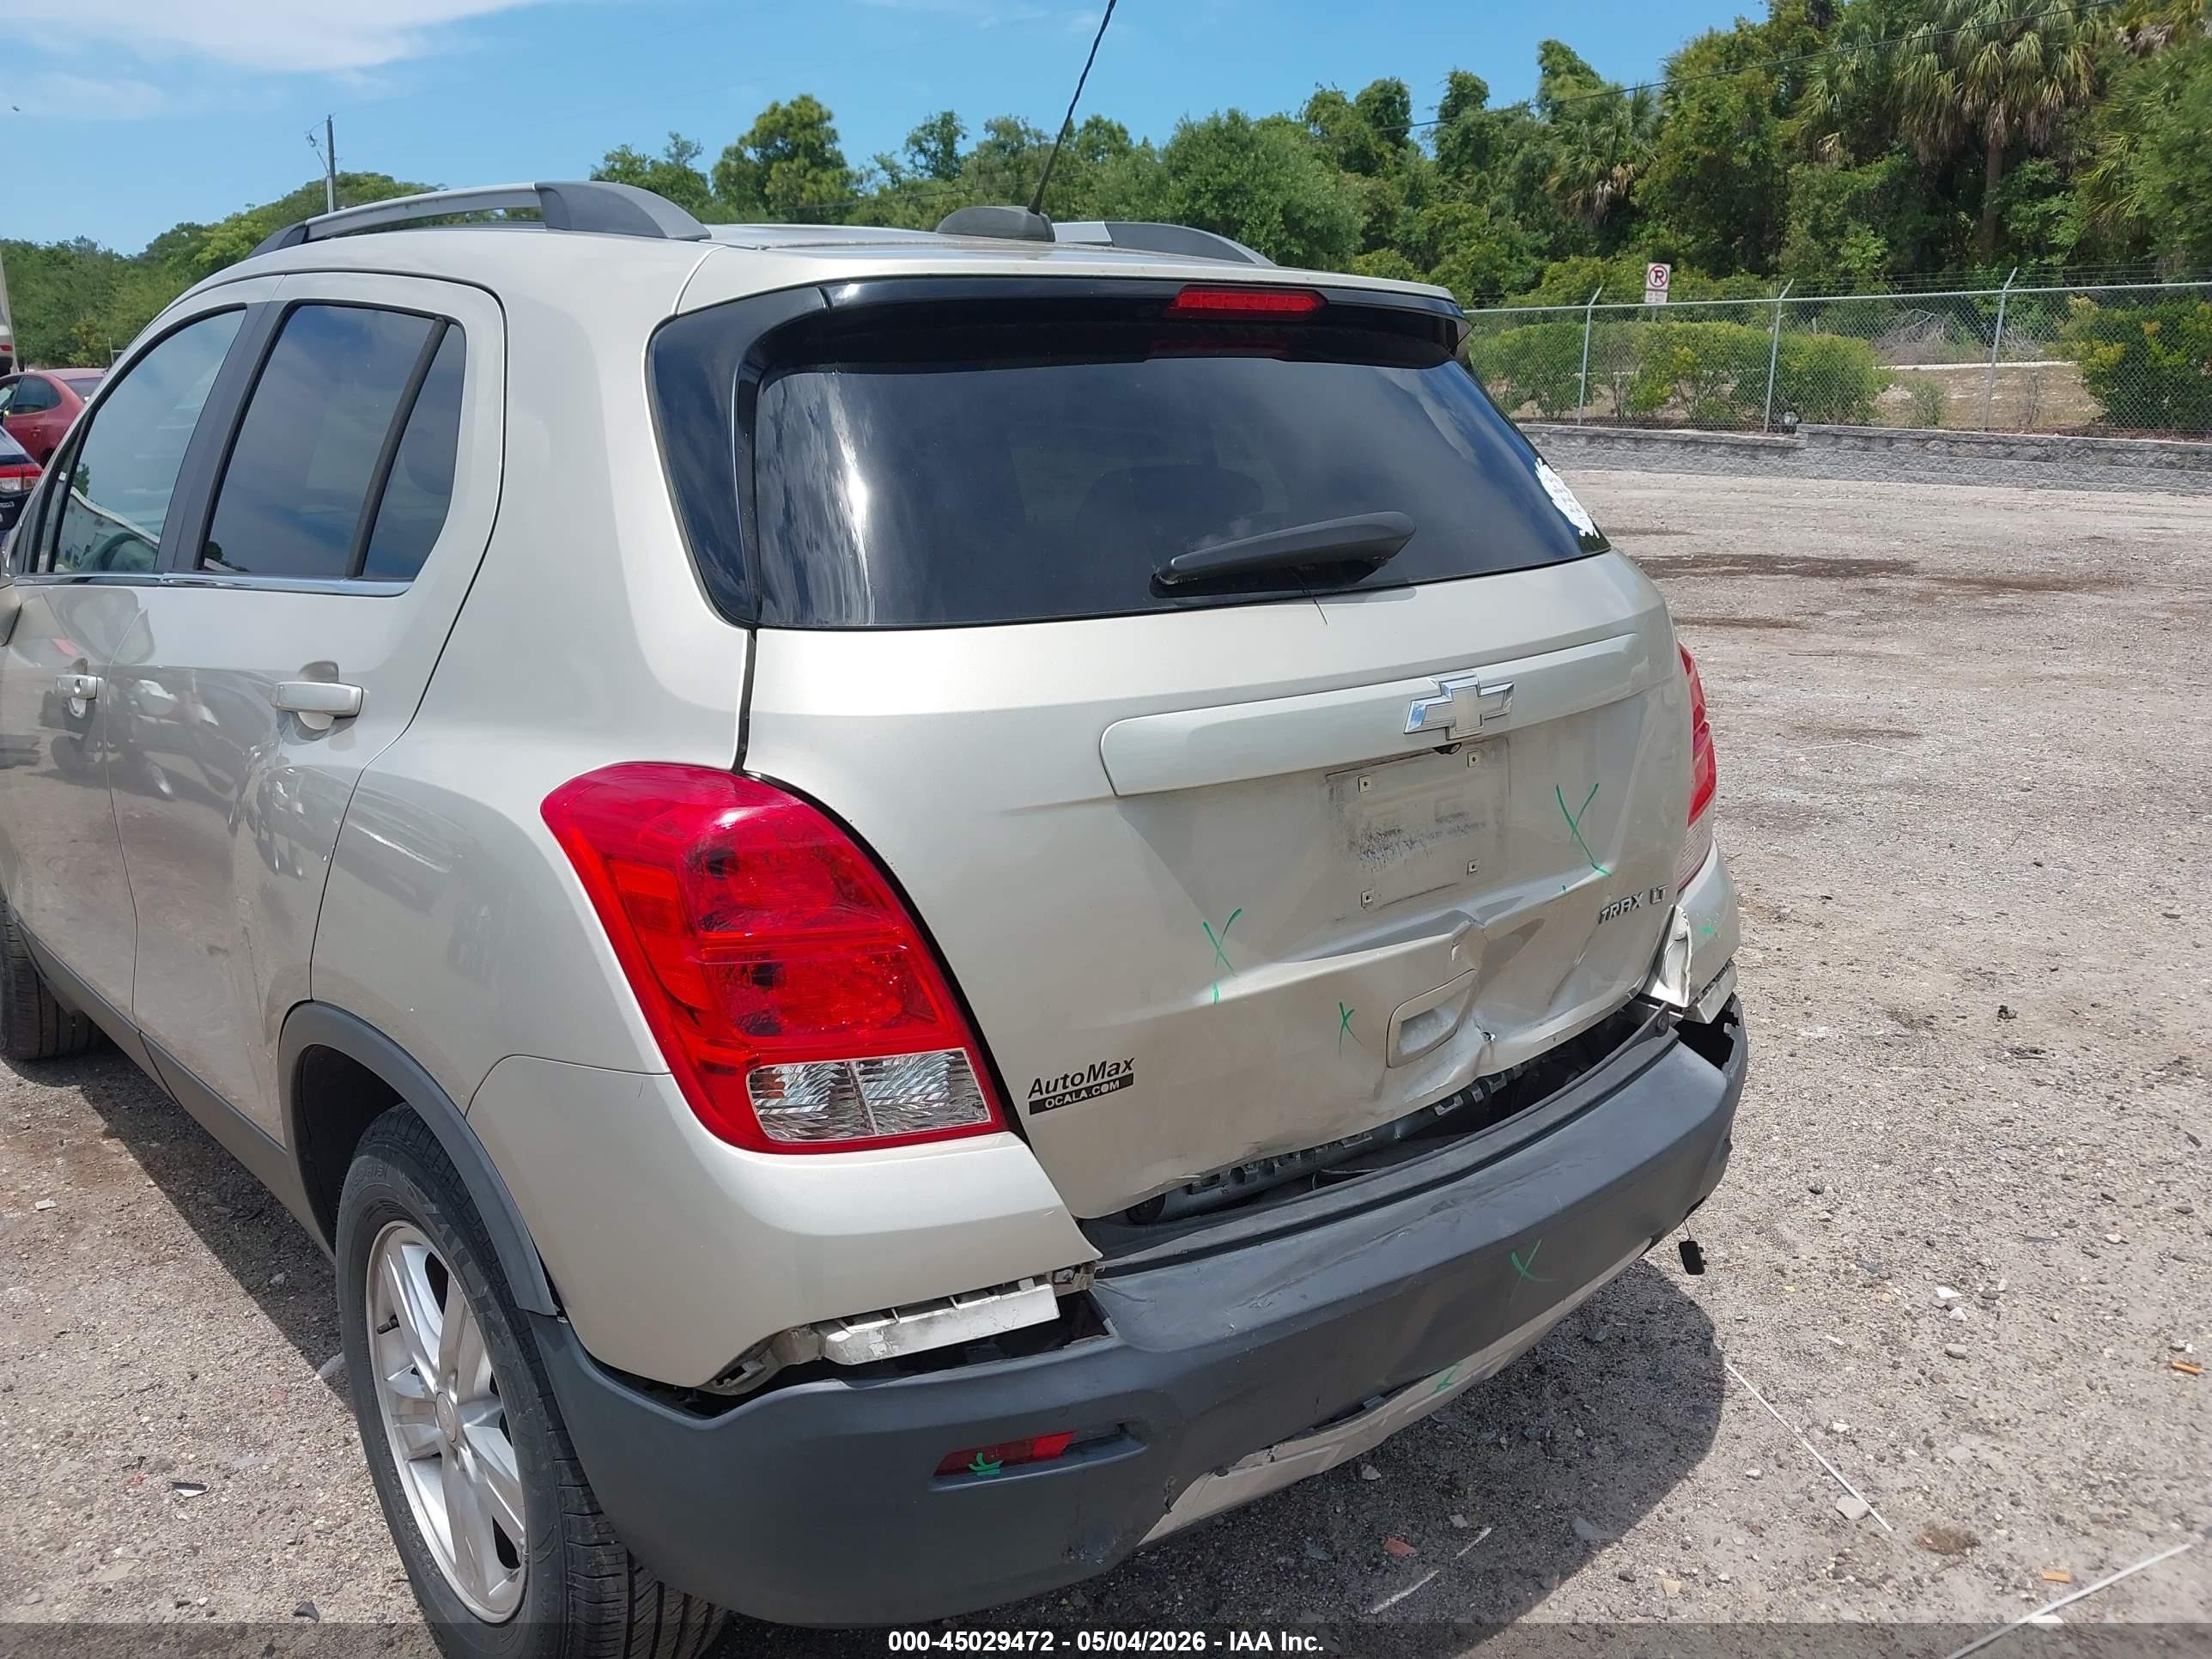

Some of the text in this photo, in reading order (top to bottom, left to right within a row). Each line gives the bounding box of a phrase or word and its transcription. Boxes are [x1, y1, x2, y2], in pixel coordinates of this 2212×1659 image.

[1598, 884, 1669, 925] TRAX LT
[1027, 1057, 1135, 1099] AutoMax
[1045, 1079, 1120, 1109] OCALA.COM
